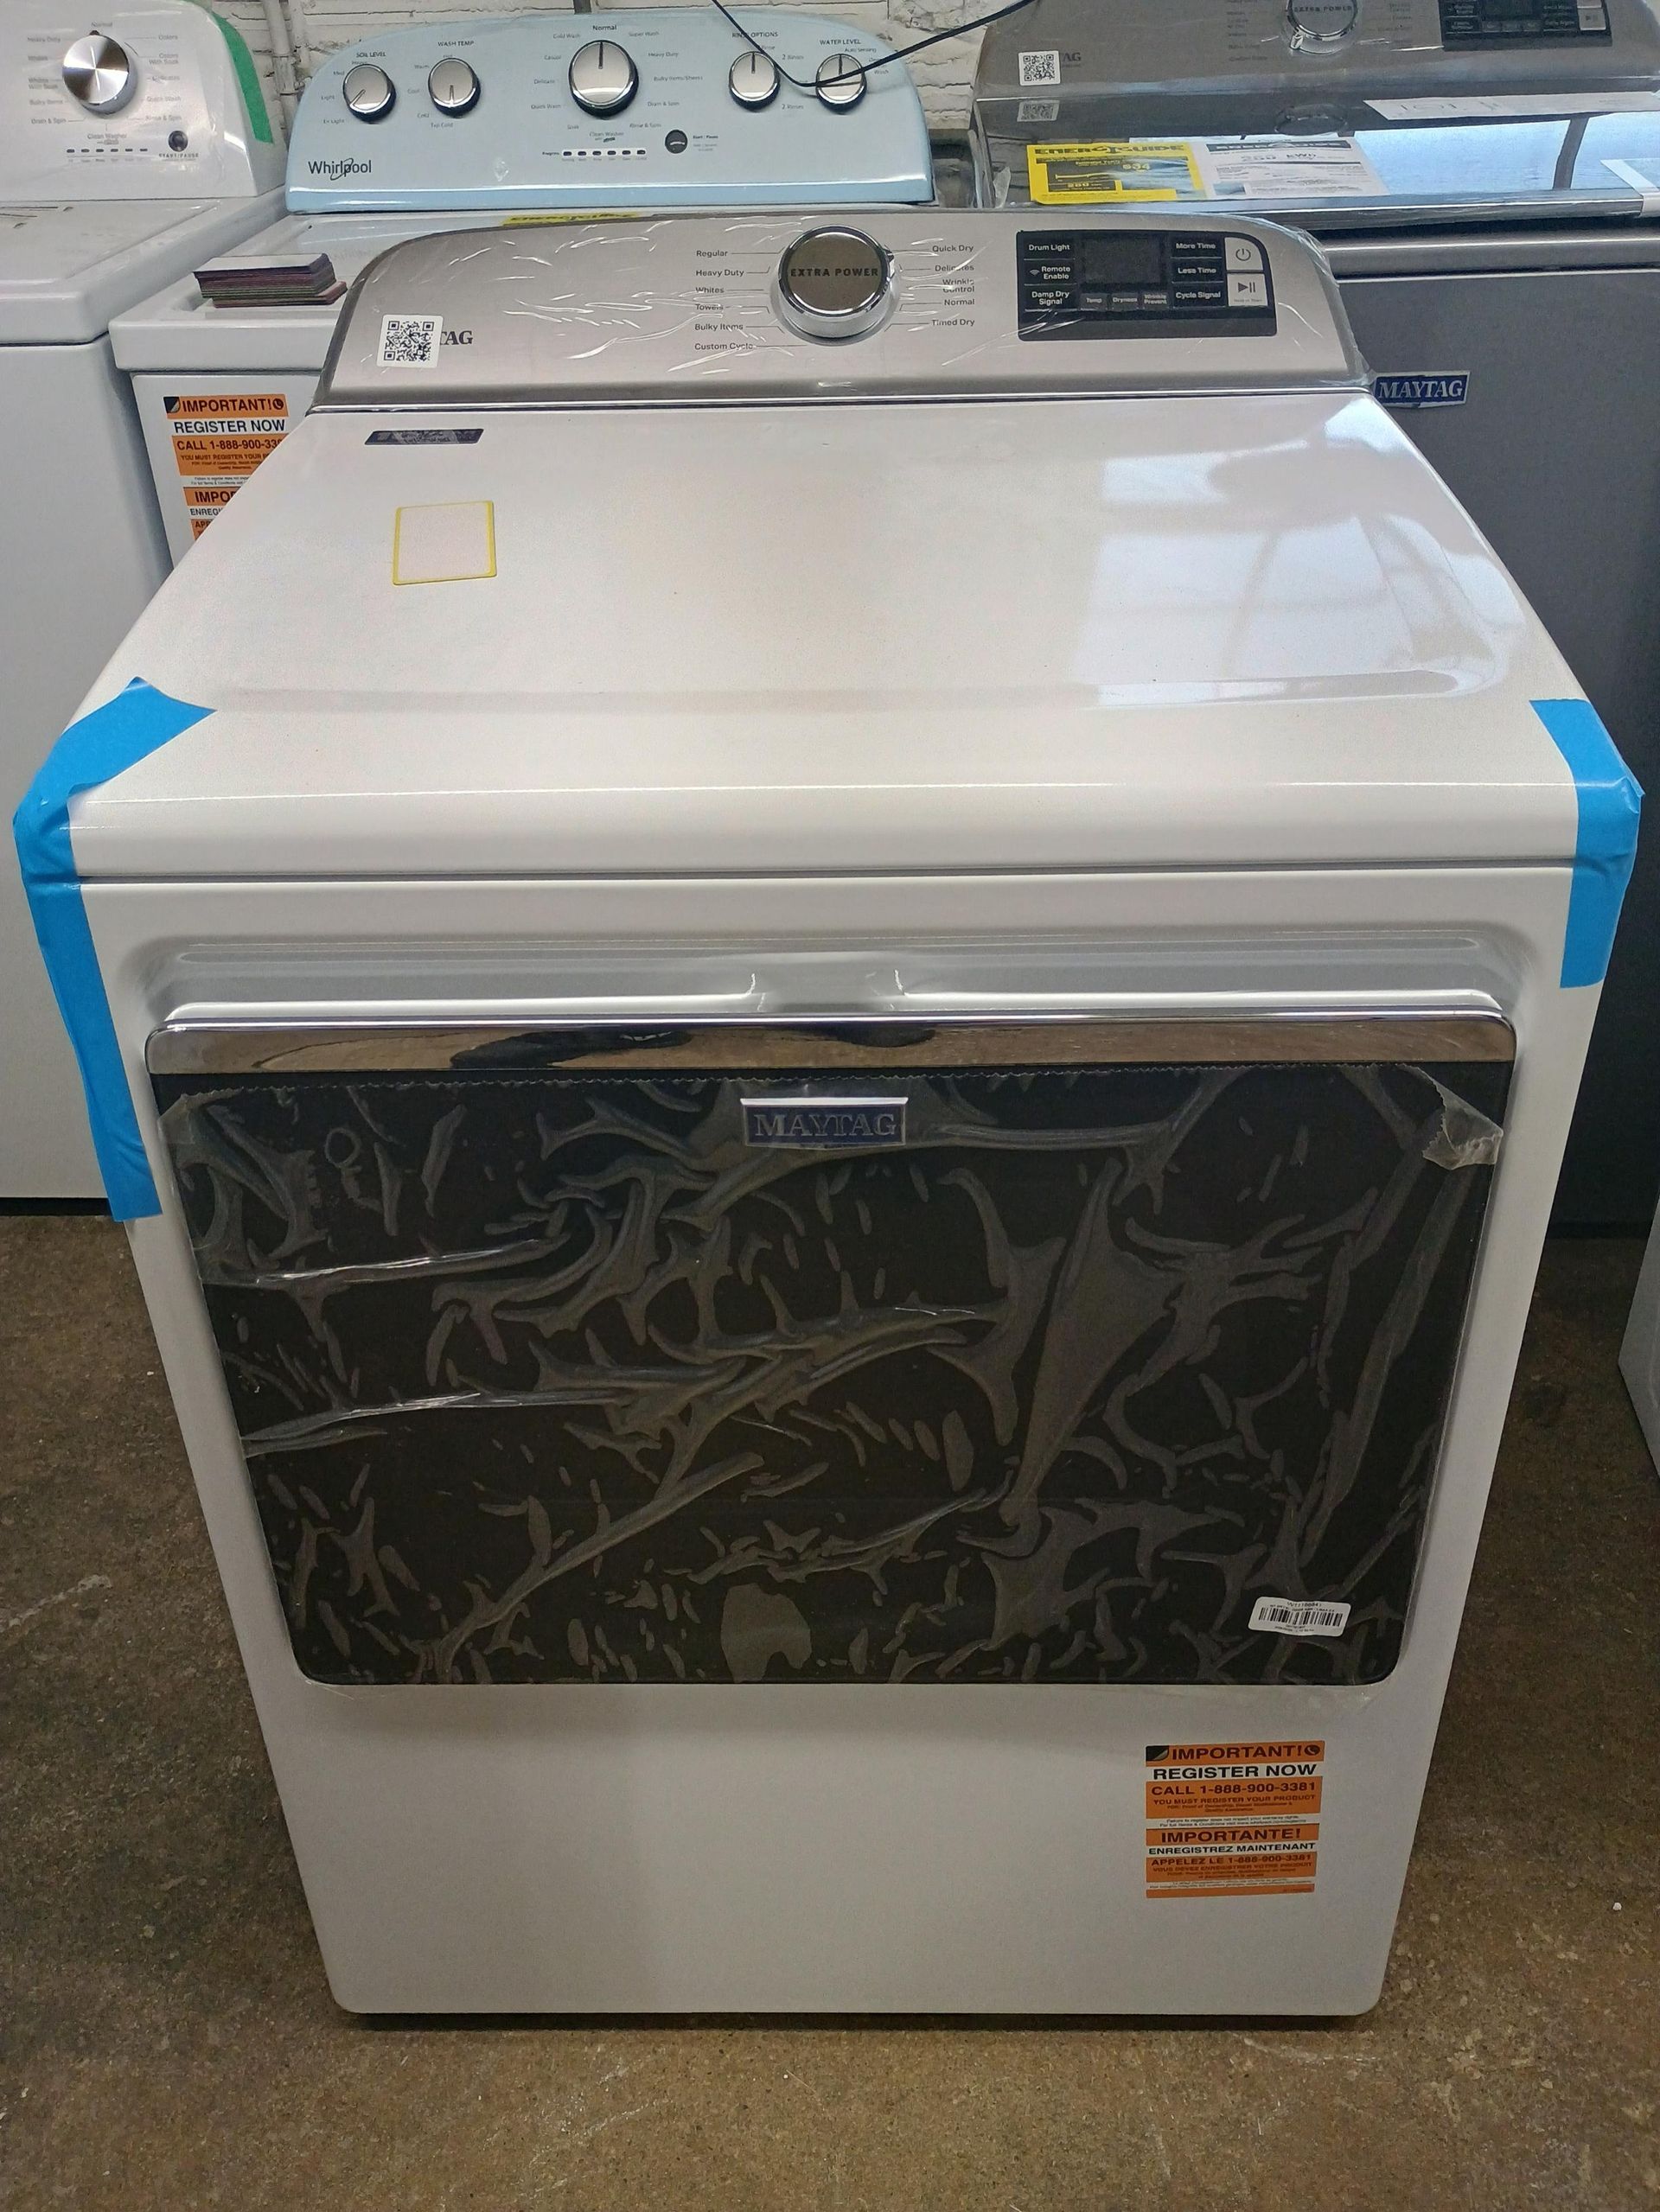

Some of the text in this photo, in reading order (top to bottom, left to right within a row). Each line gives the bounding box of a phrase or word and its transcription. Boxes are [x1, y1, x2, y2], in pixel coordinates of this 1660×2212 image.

[308, 159, 372, 179] Whirlpool
[696, 249, 728, 258] Regular
[932, 244, 974, 253] Quick Dry
[696, 269, 744, 277] Heavy Duty
[790, 267, 878, 277] EXTRA POWER
[695, 323, 722, 332] Bulky
[1379, 380, 1463, 398] MAYTAG
[182, 398, 271, 414] IMPORTANT!
[174, 419, 285, 434] REGISTER NOW
[177, 441, 207, 450] CALL
[754, 1113, 897, 1137] MAYTAG
[1172, 1745, 1301, 1760] IMPORTANT!
[1153, 1764, 1317, 1780] REGISTER NOW
[1152, 1782, 1315, 1795] CALL 1-888-900-3381
[1161, 1828, 1300, 1843] IMPORTANTE!
[1149, 1843, 1316, 1855] ENREGISTREZ MAINTENANT
